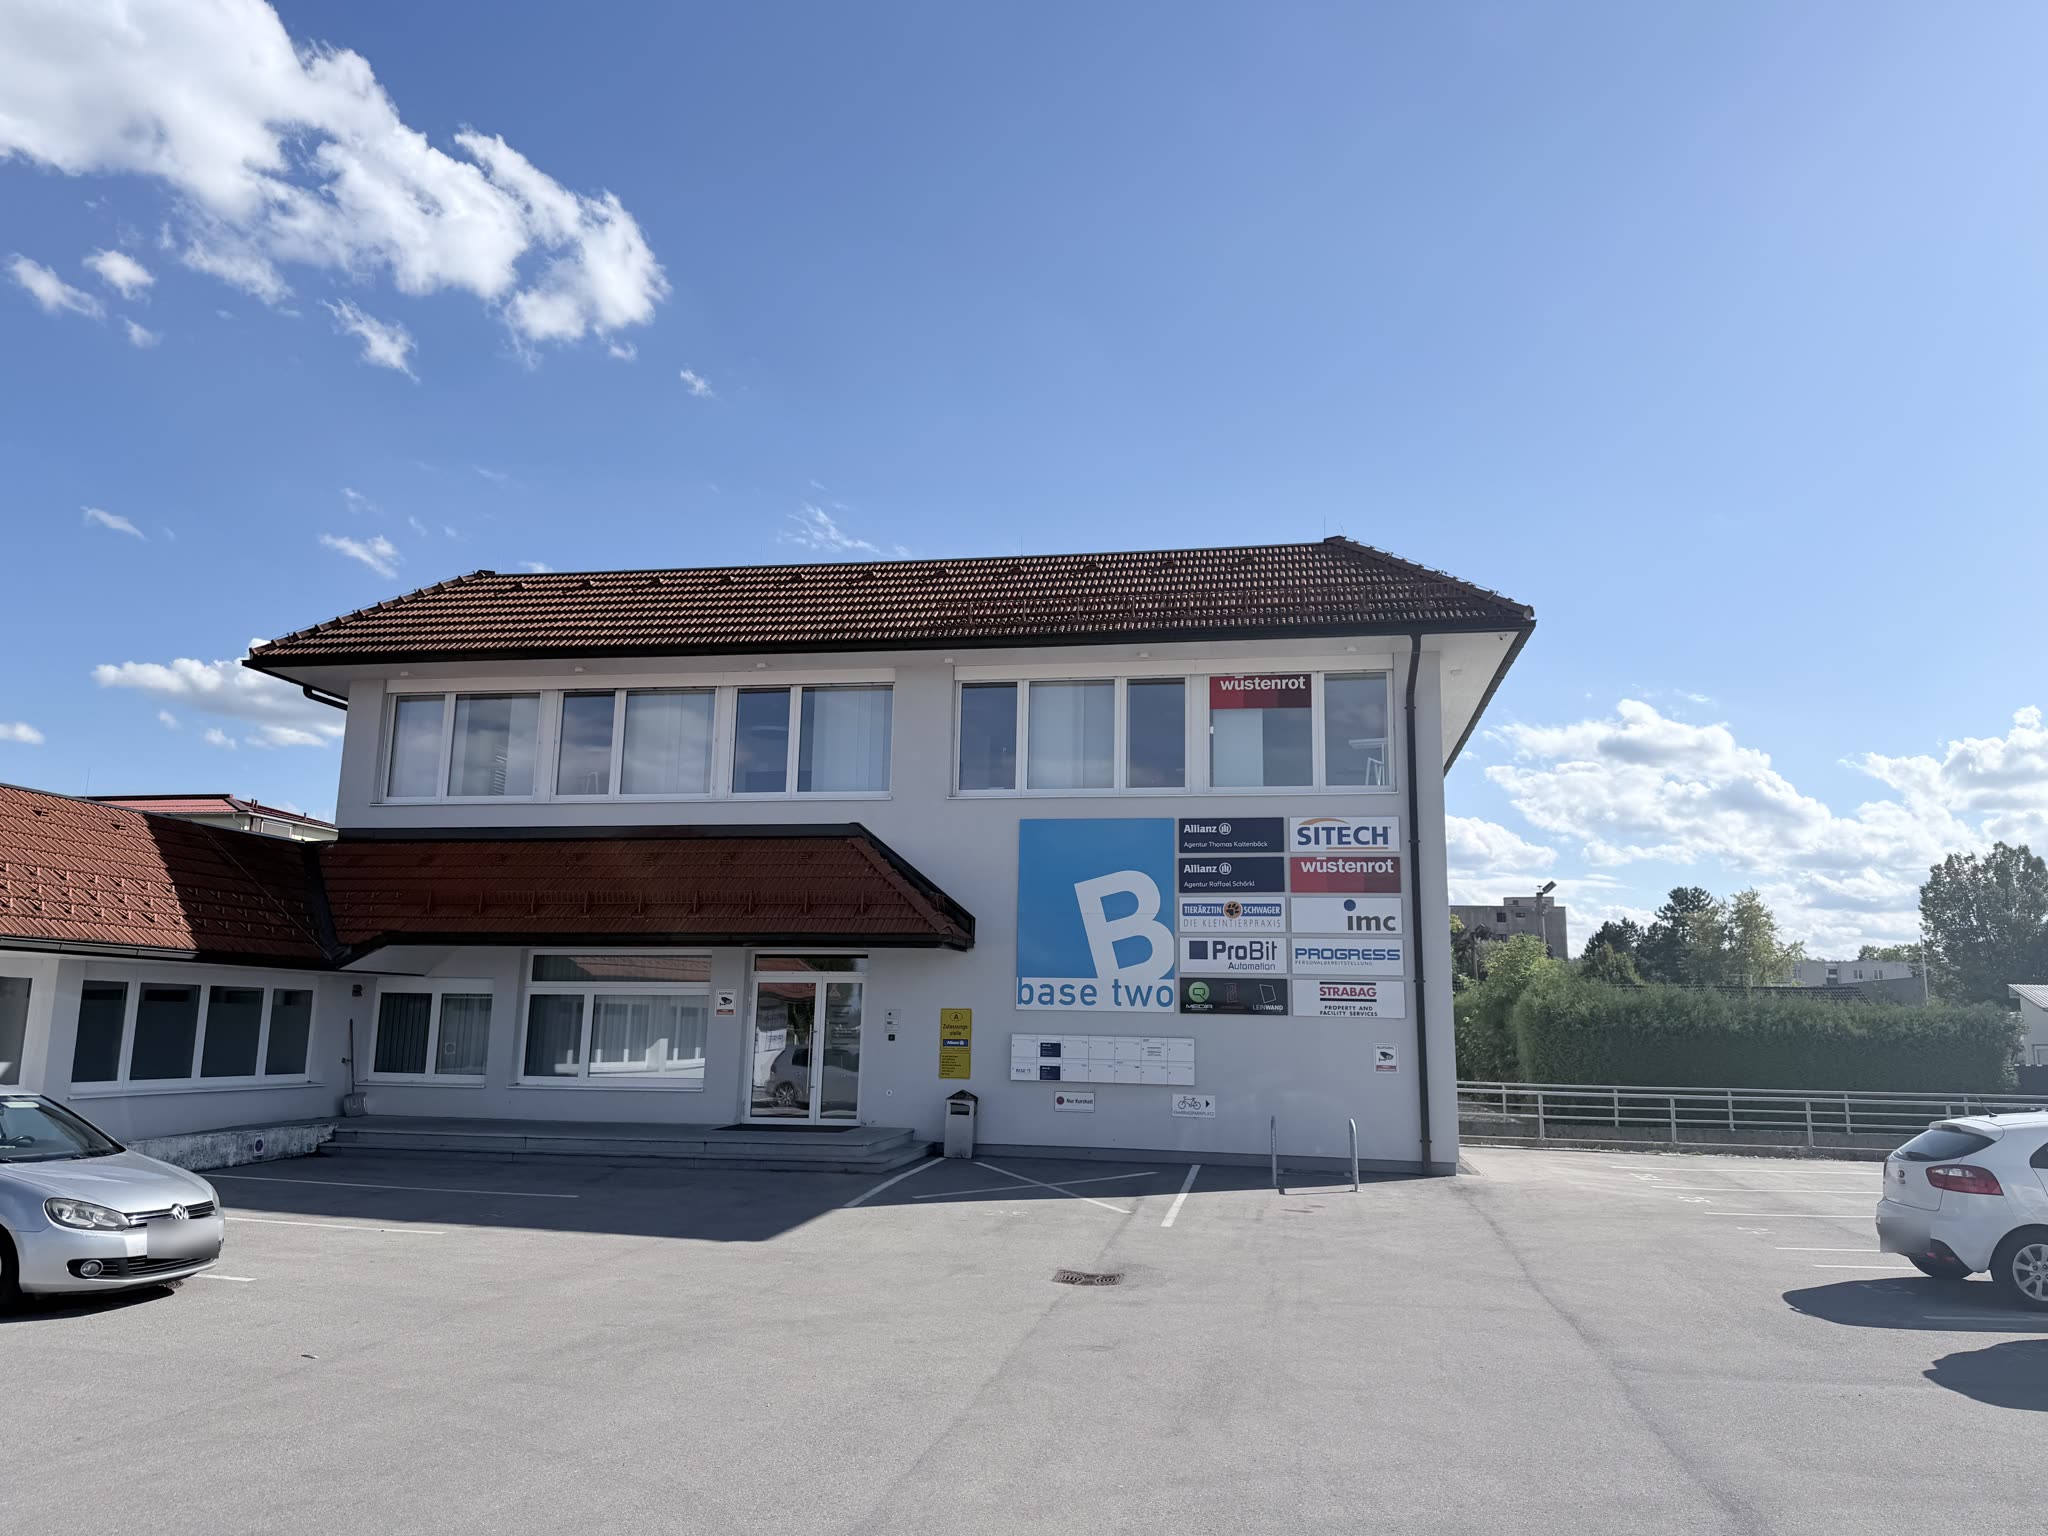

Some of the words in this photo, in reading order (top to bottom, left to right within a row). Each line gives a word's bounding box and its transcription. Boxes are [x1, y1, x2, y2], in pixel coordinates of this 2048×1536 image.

[1220, 675, 1305, 690] wüstenrot
[1184, 824, 1217, 833] Allianz
[1297, 826, 1388, 845] SITECH
[1184, 864, 1218, 873] Allianz
[1301, 857, 1394, 873] wüstenrot
[1184, 905, 1221, 914] TIERÄRZTIN
[1244, 906, 1280, 914] SCHWAGER
[1344, 899, 1396, 931] imc
[1184, 919, 1197, 927] DIE
[1203, 919, 1280, 927] KLEINTIERPRAXIS
[1213, 941, 1277, 960] ProBit
[1295, 948, 1400, 960] PROGRESS
[1228, 962, 1275, 970] Automation
[1018, 977, 1097, 1005] base
[1112, 979, 1173, 1007] two
[1320, 987, 1376, 997] STRABAG
